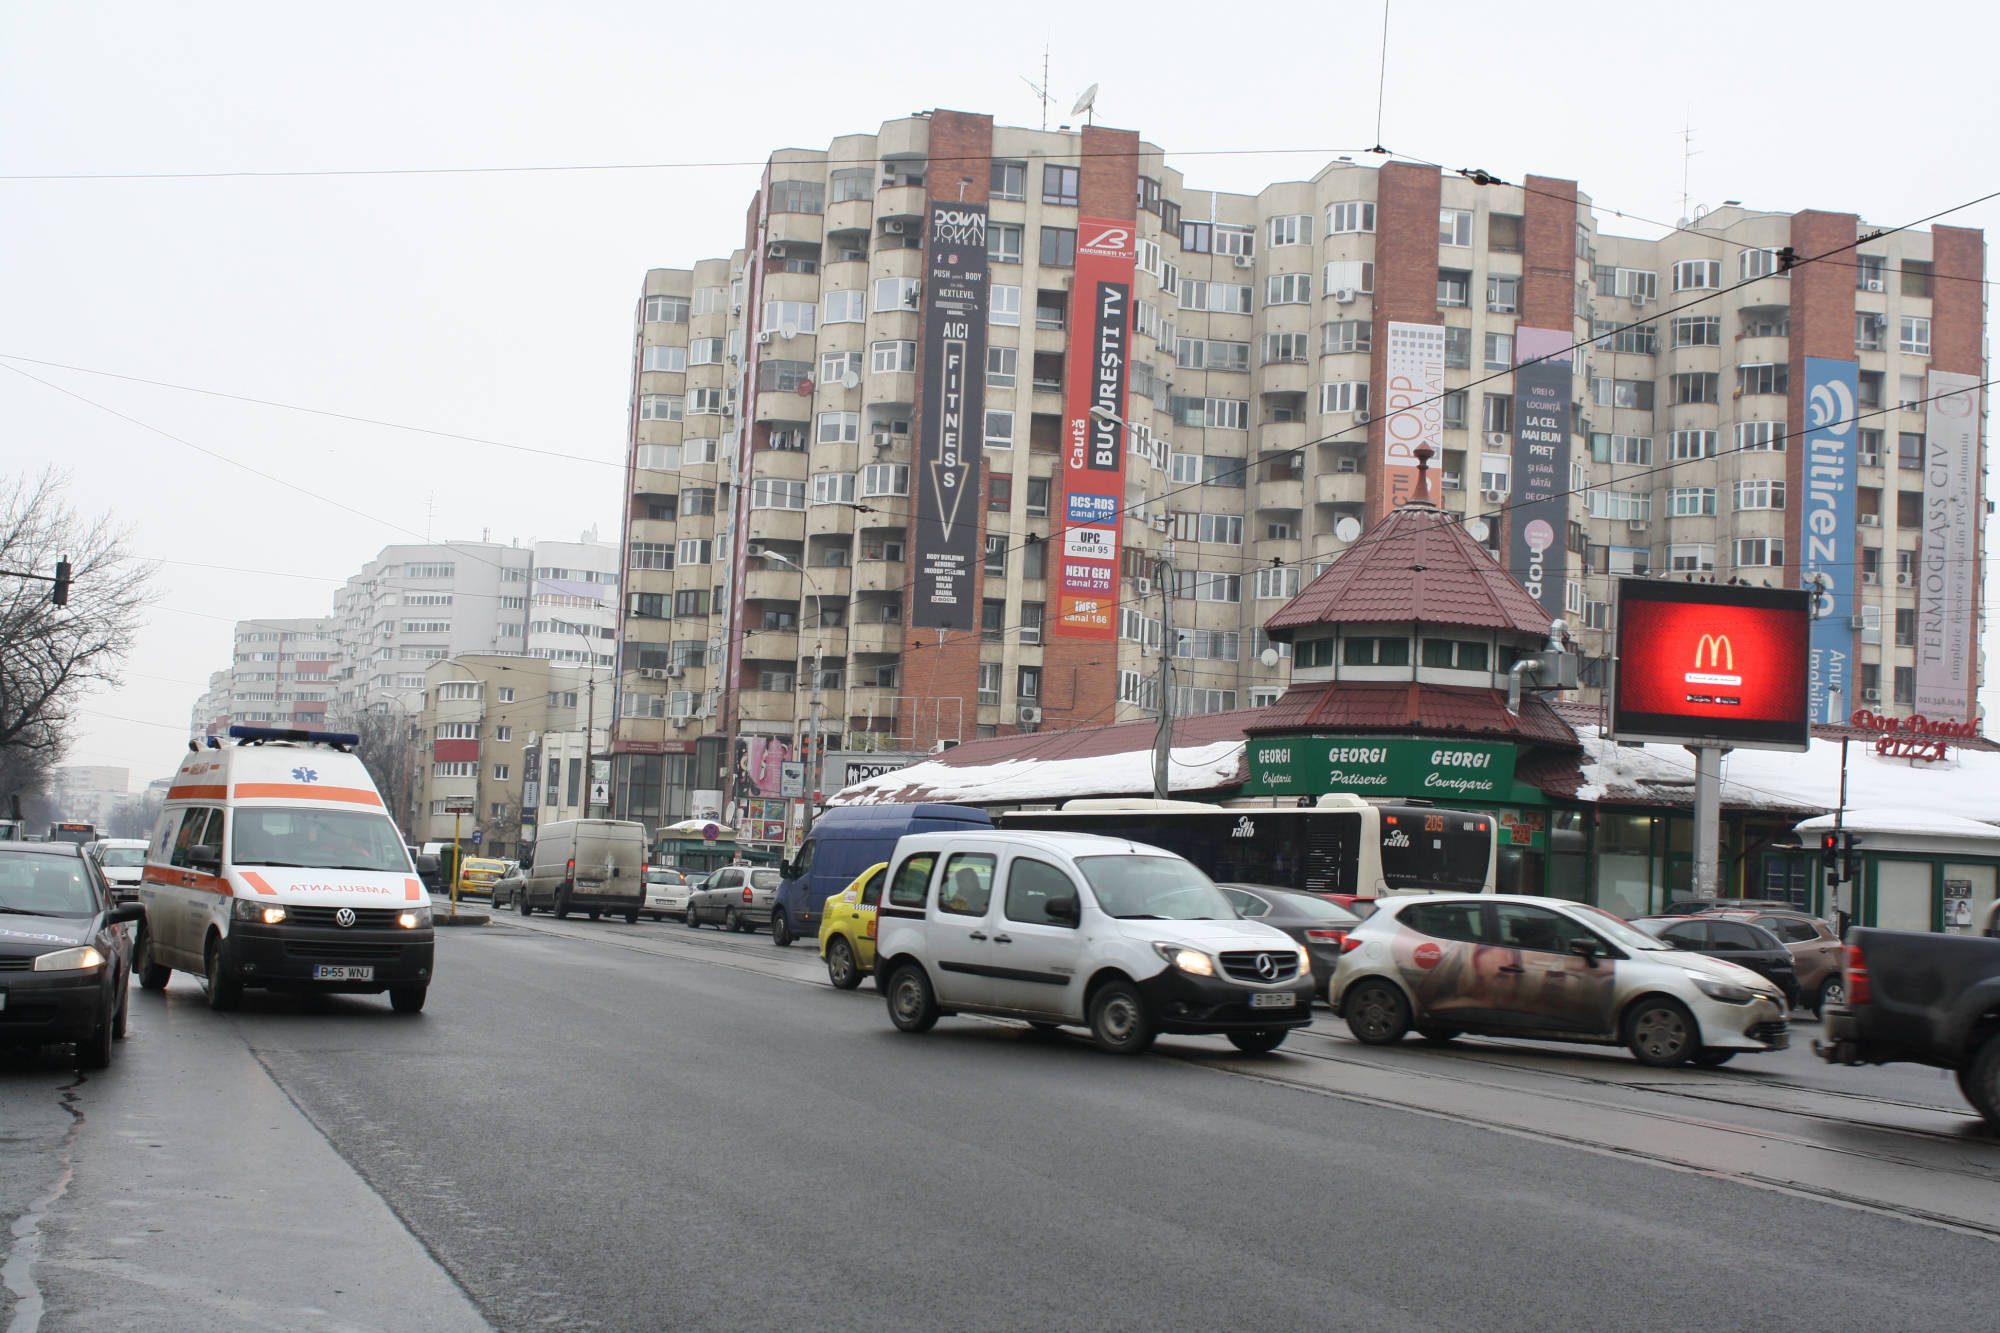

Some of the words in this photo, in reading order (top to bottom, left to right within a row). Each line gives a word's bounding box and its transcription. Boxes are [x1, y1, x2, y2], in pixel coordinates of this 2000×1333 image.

[935, 210, 986, 227] DOWN
[934, 269, 950, 278] PUSH
[965, 272, 982, 281] BODY
[1104, 286, 1122, 318] TV
[942, 322, 968, 339] AICI
[1532, 386, 1548, 395] VREI
[942, 354, 960, 488] FITNESS
[1388, 376, 1423, 459] POPP
[1526, 416, 1538, 426] LA
[1540, 417, 1558, 428] CEL
[1070, 418, 1086, 469] Caută
[1522, 430, 1540, 440] MAI
[1541, 431, 1561, 442] BUN
[1530, 445, 1555, 460] PREȚ
[1930, 442, 1948, 488] CIV
[1070, 495, 1114, 510] RCS-RDS
[1526, 492, 1535, 500] DE
[1070, 509, 1095, 518] canal
[1080, 531, 1100, 544] UPC
[1071, 544, 1095, 553] canal
[1098, 546, 1108, 555] 95
[1066, 565, 1090, 578] NEXT
[1091, 566, 1111, 579] GEN
[1066, 579, 1091, 588] canal
[1093, 580, 1109, 589] 276
[1923, 497, 1946, 666] TERMOGLASS
[1850, 709, 1900, 731] Don
[1904, 714, 1982, 738] Daniel
[1258, 748, 1291, 764] GEORGI
[1328, 748, 1387, 764] GEORGI
[1876, 737, 1948, 762] PIZZA
[1431, 750, 1491, 769] GEORGI
[1330, 770, 1388, 785] Patiserie
[1424, 772, 1494, 794] Covrigarie
[1424, 815, 1444, 832] 205
[348, 967, 370, 978] WNJ
